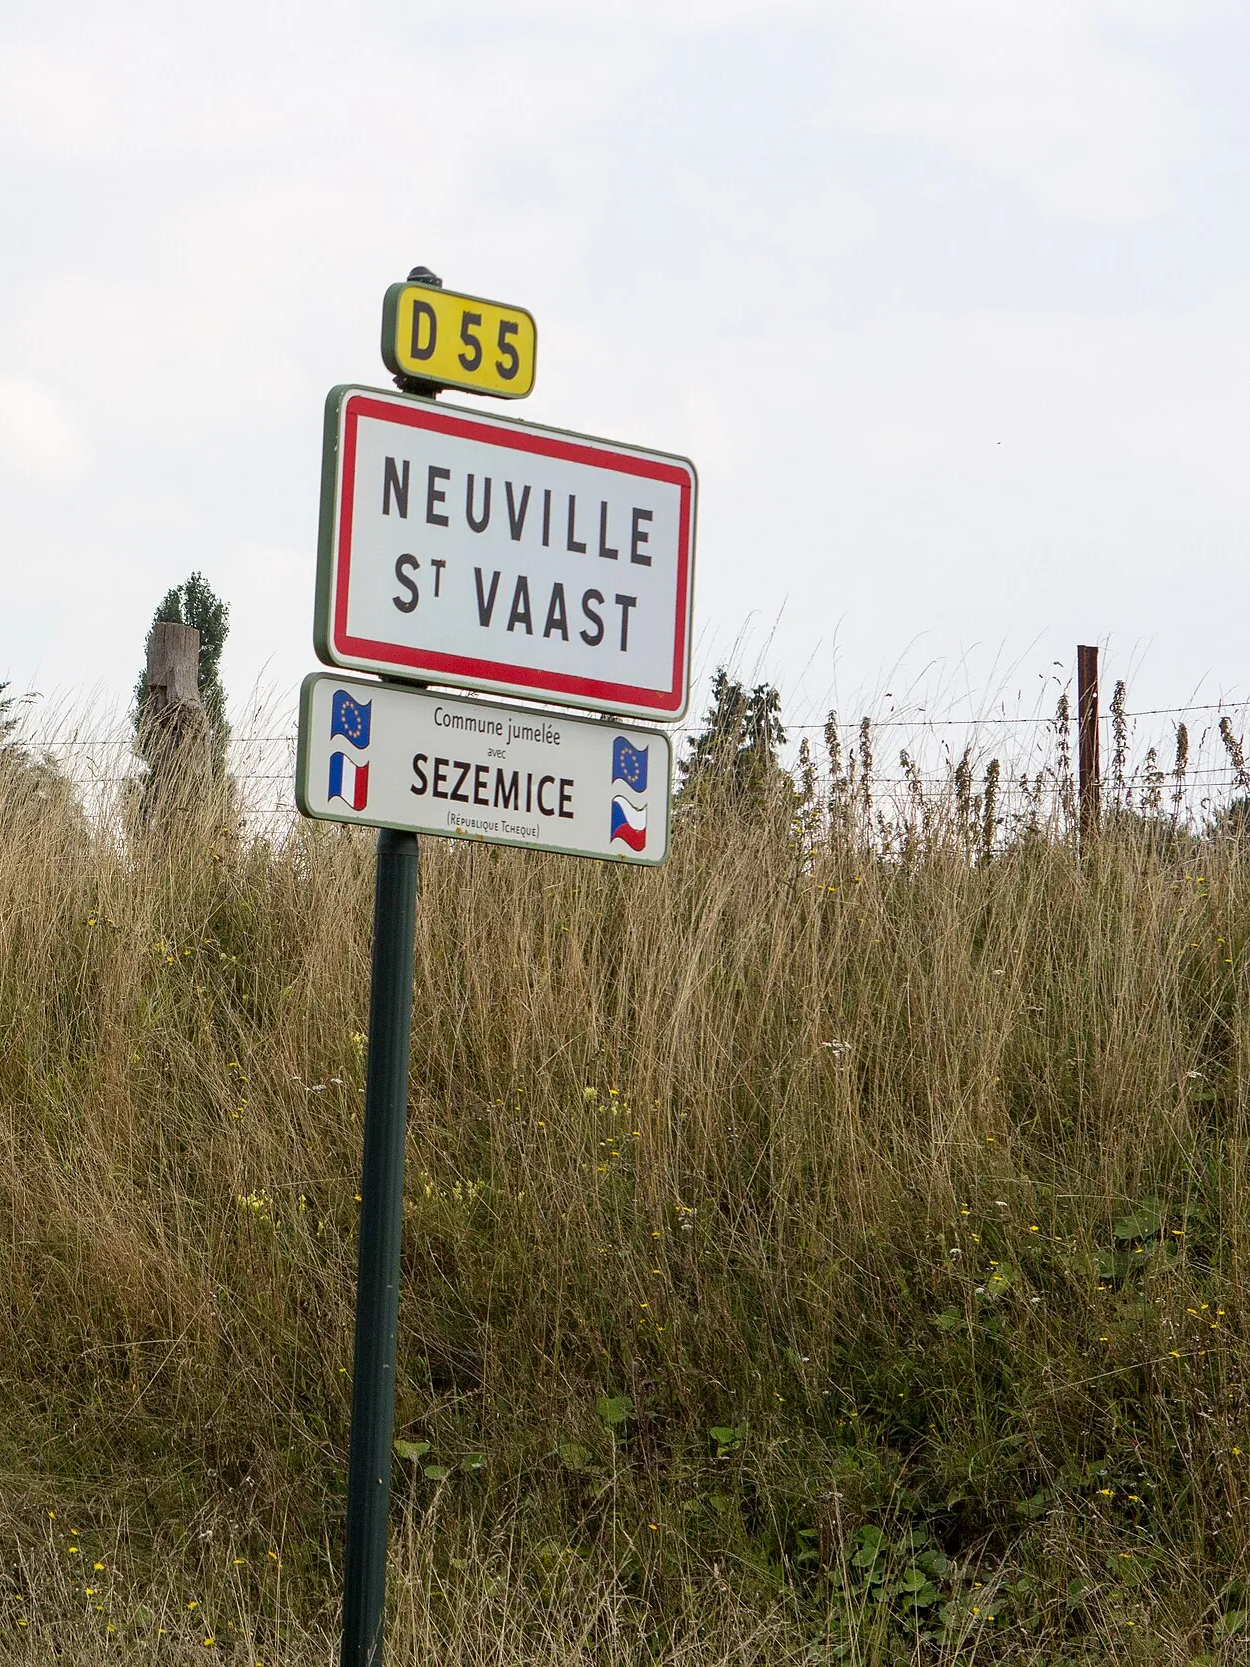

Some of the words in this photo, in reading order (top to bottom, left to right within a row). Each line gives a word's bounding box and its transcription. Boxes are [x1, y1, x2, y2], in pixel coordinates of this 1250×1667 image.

[410, 299, 437, 361] D
[458, 310, 519, 380] 55
[382, 456, 653, 566] NEUVILLE
[474, 567, 637, 652] VAAST
[434, 706, 503, 736] Commune
[506, 718, 561, 745] jumelée
[487, 747, 507, 759] avec
[410, 753, 574, 819] SEZEMICE
